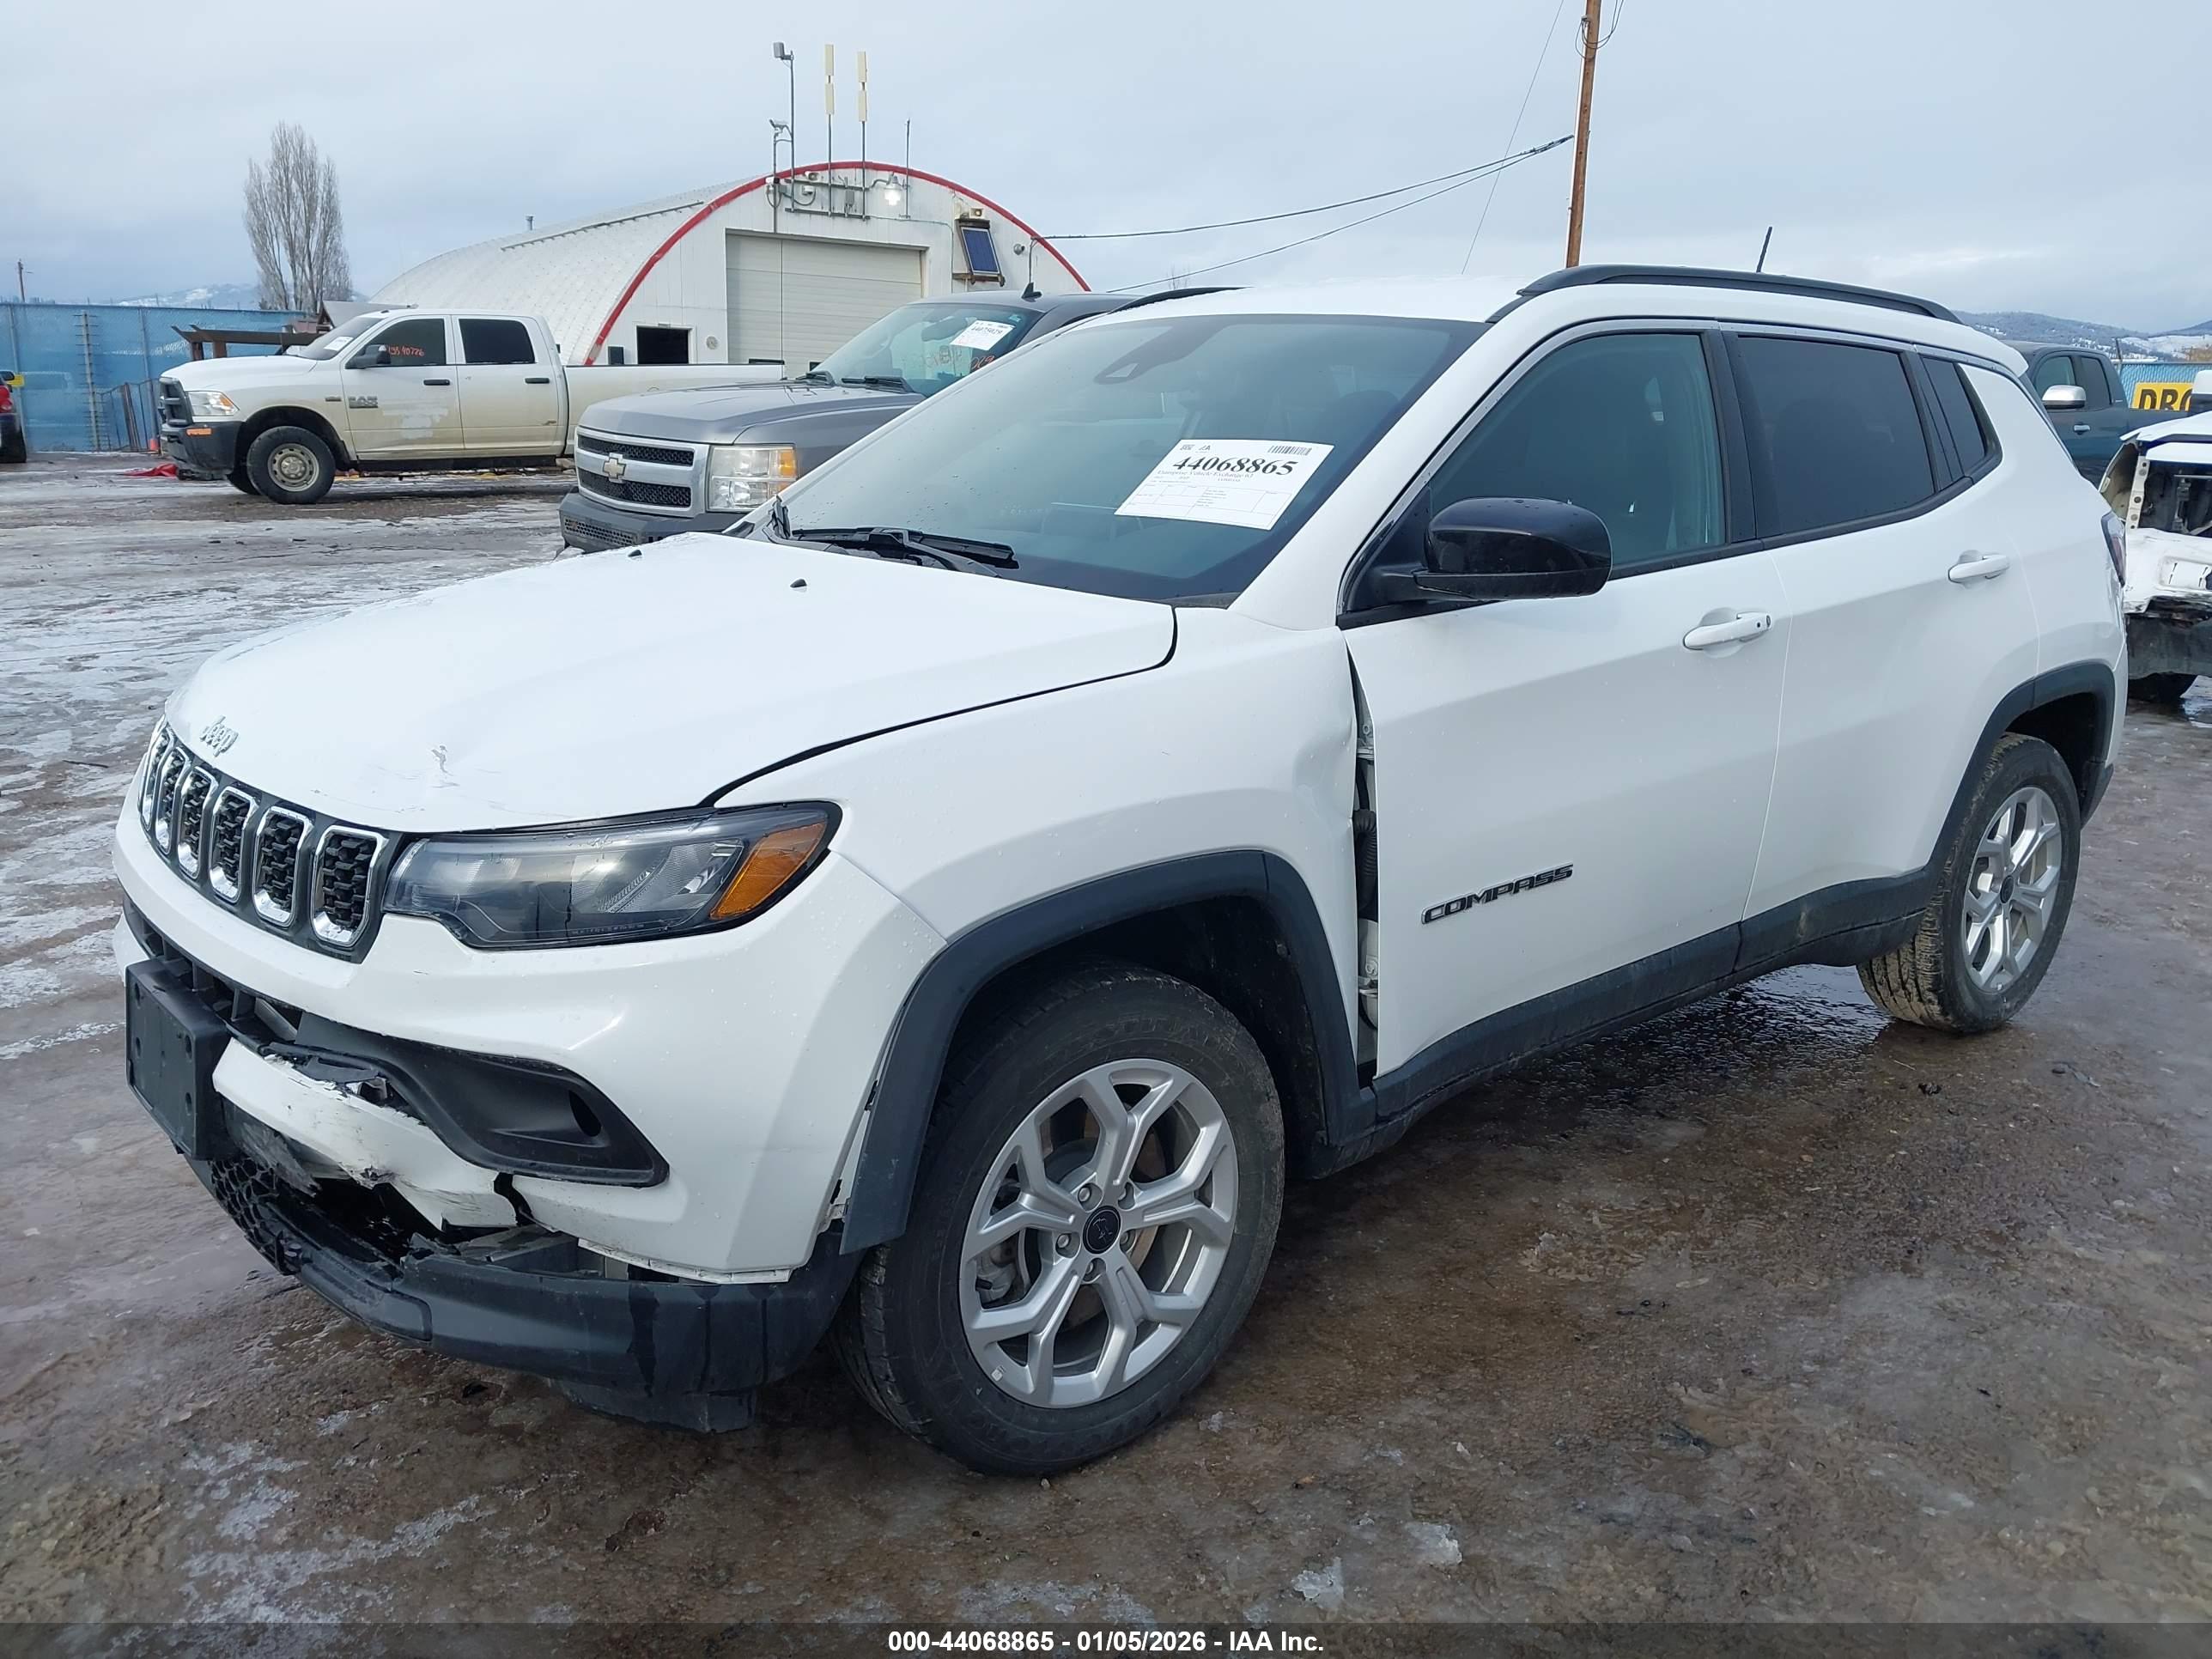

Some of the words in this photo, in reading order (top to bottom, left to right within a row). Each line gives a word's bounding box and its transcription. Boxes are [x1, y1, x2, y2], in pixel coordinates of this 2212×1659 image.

[1173, 456, 1299, 476] 44068865
[198, 714, 240, 757] Jeep
[1421, 860, 1574, 925] COMPASS
